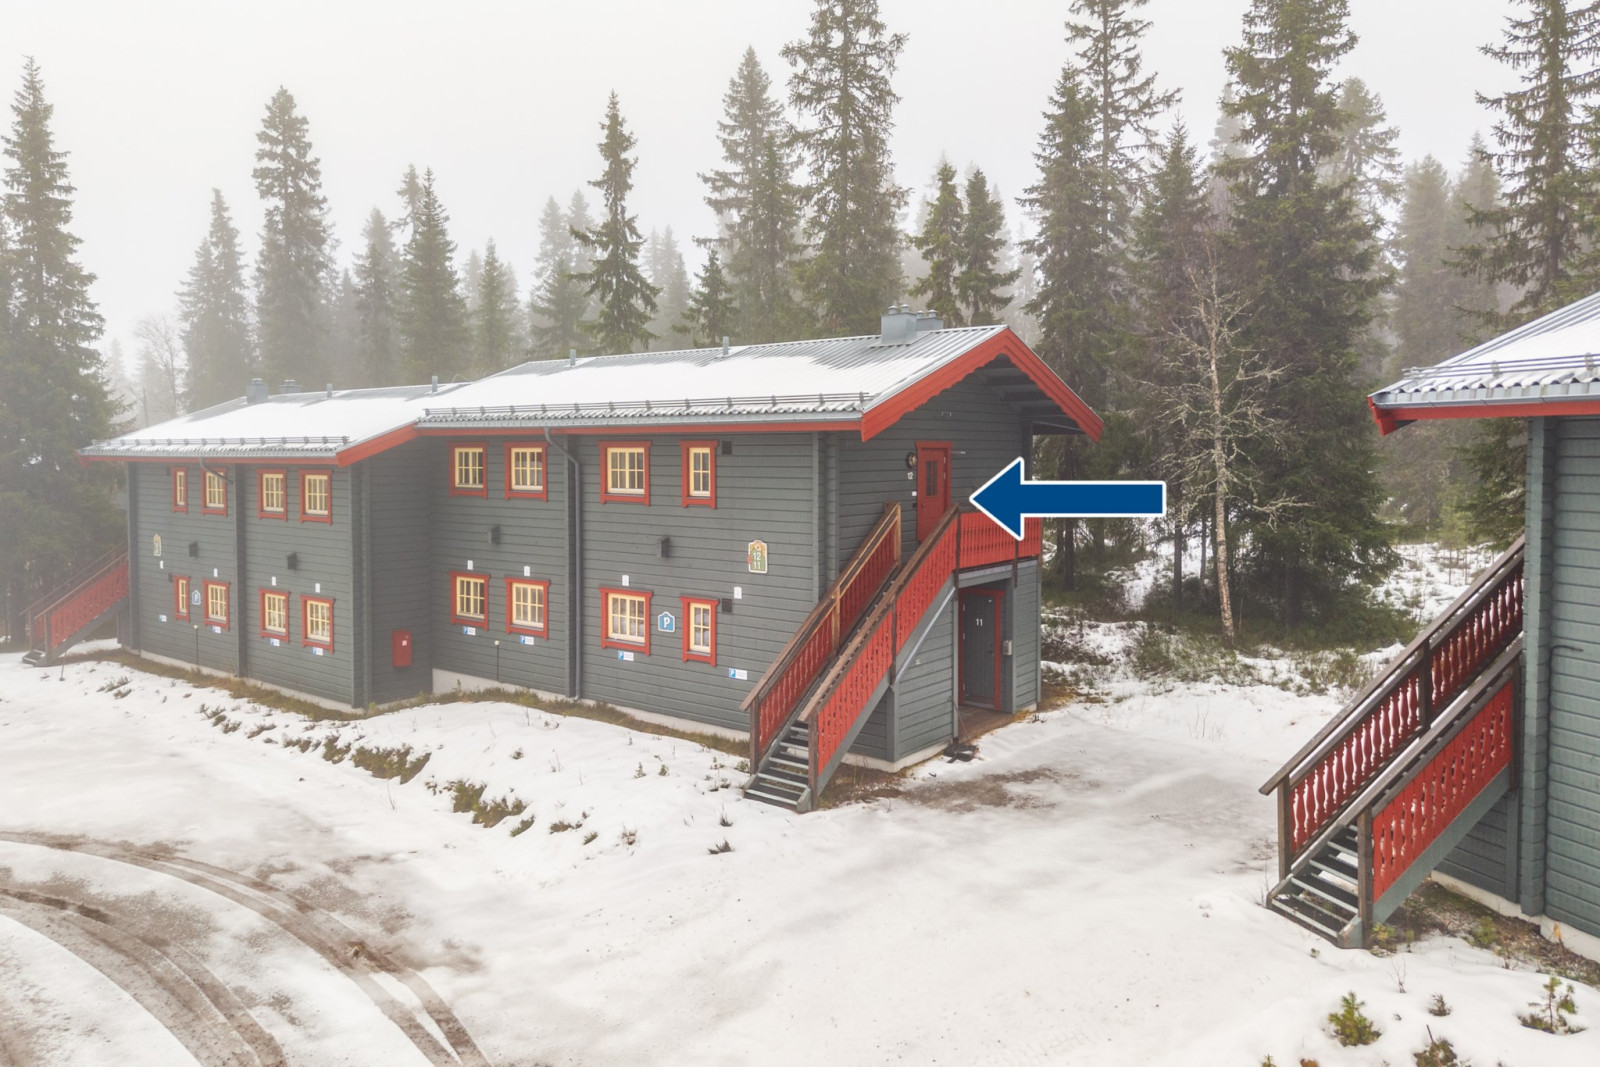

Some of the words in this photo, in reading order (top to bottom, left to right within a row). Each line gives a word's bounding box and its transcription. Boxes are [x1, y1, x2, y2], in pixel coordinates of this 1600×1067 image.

[753, 552, 761, 560] 12
[753, 561, 761, 569] 11
[663, 616, 670, 628] P
[976, 618, 983, 626] 11
